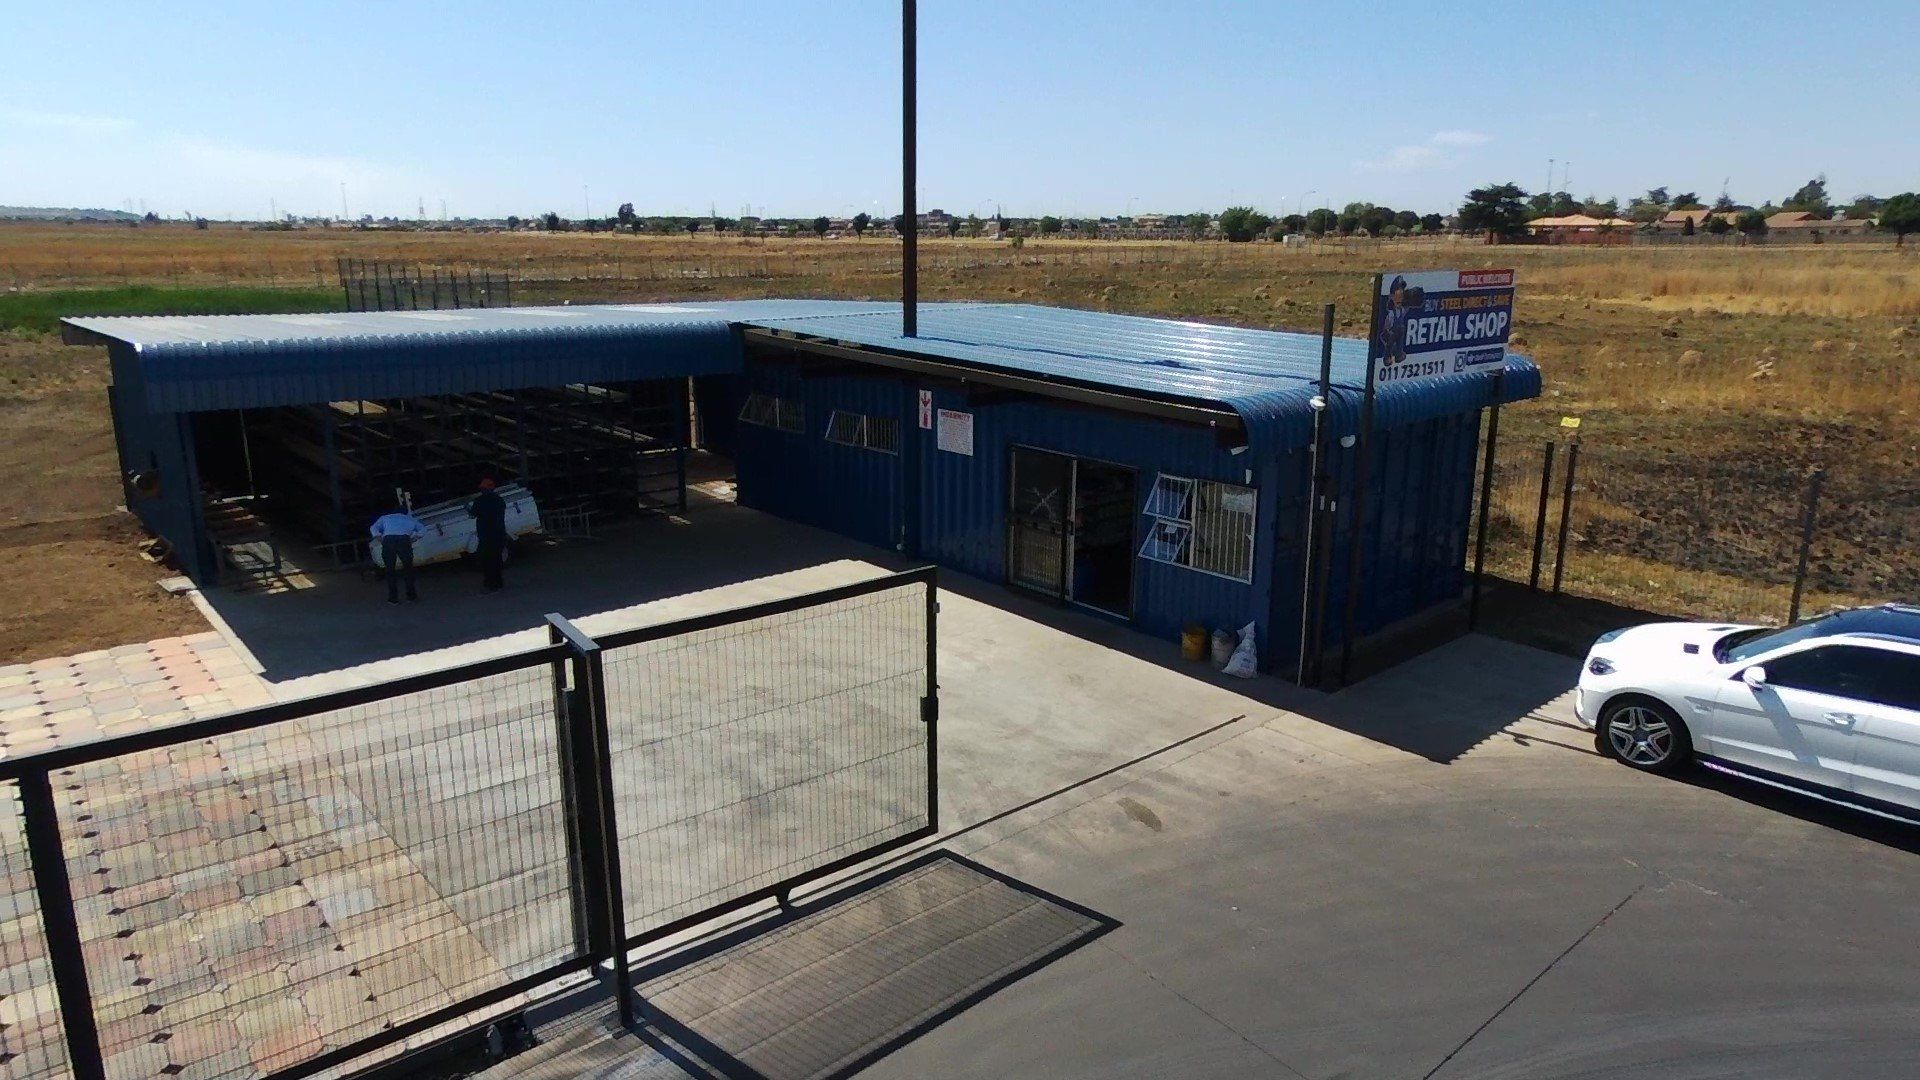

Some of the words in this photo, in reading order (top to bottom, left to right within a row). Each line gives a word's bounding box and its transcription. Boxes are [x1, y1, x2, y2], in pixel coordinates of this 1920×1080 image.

[1461, 274, 1483, 285] PUBLIC
[1483, 273, 1511, 284] WELCOME
[1440, 297, 1461, 310] STEEL
[1405, 316, 1462, 346] RETAIL
[1464, 311, 1508, 340] SHOP
[1379, 366, 1398, 381] 011
[1422, 360, 1445, 376] 1511
